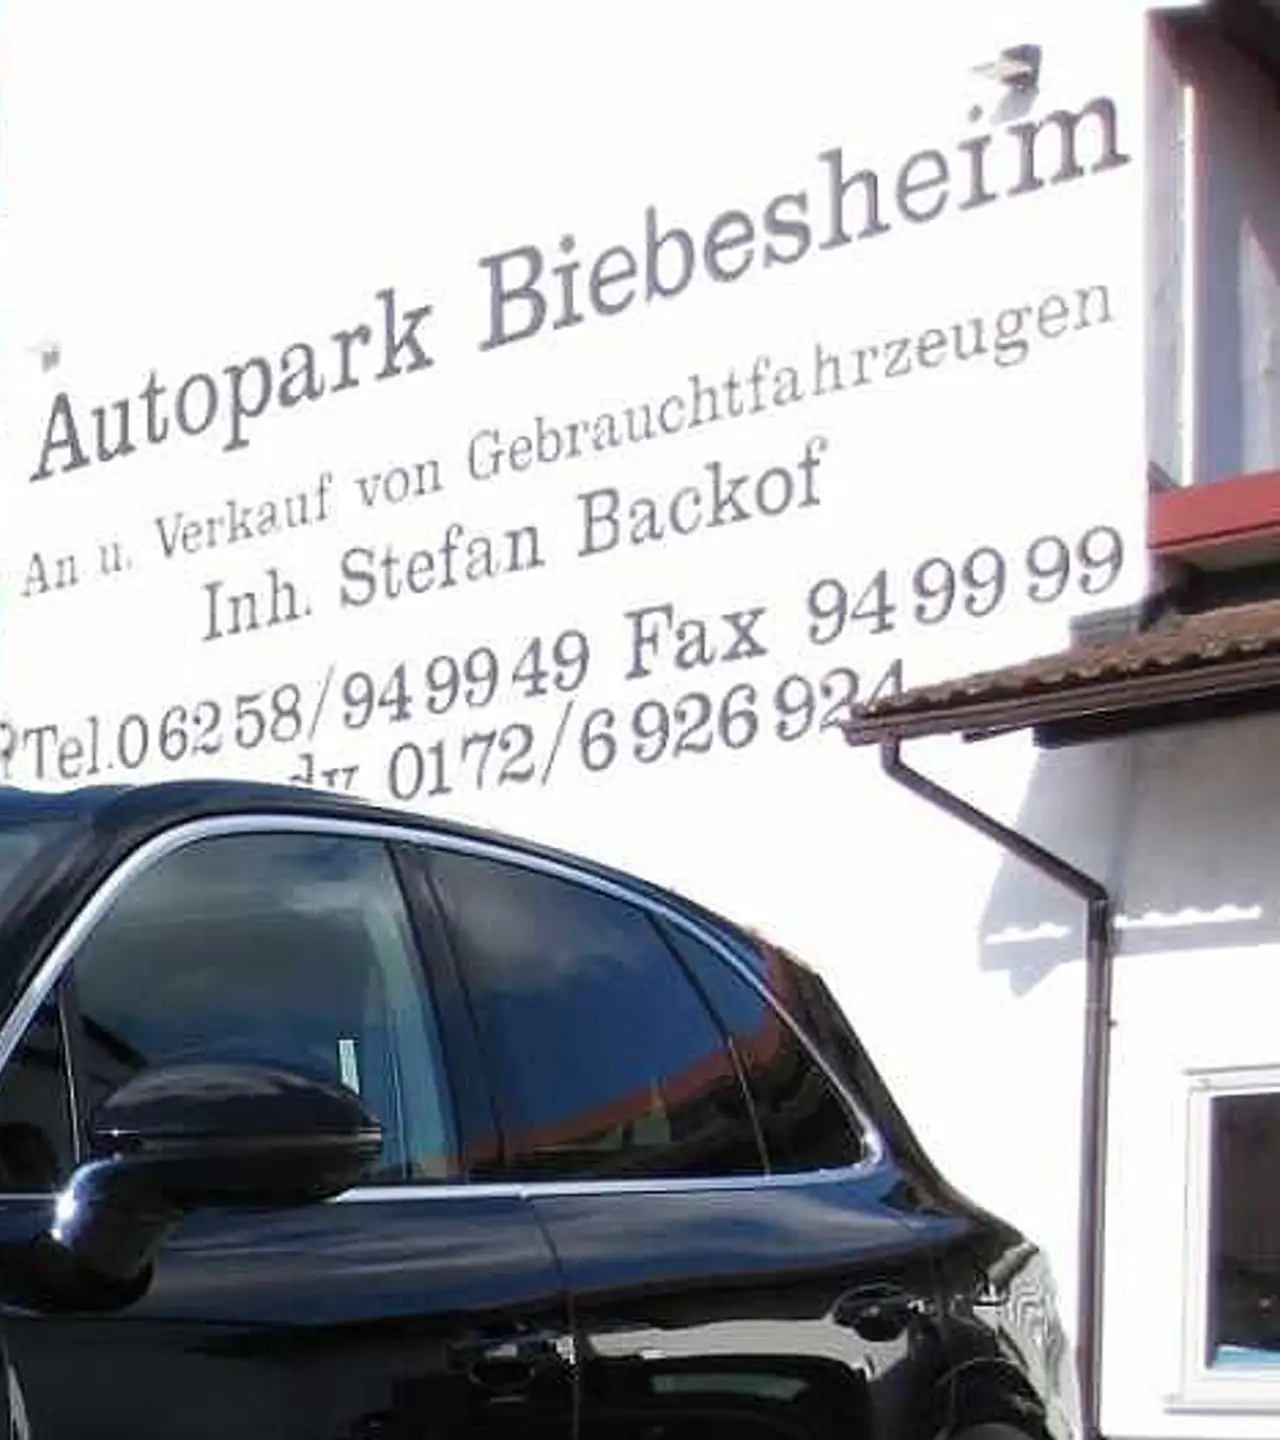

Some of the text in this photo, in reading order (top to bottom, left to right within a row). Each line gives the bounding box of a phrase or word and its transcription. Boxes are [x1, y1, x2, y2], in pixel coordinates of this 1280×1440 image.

[28, 95, 1132, 484] Autopark Biebesheim
[20, 551, 80, 598] An
[154, 470, 334, 560] Verkauf
[353, 458, 444, 508] von
[466, 283, 1113, 482] Gebrauchtfahrzeugen
[201, 434, 829, 643] Inh. Stefan Backof
[622, 601, 770, 682] Fax
